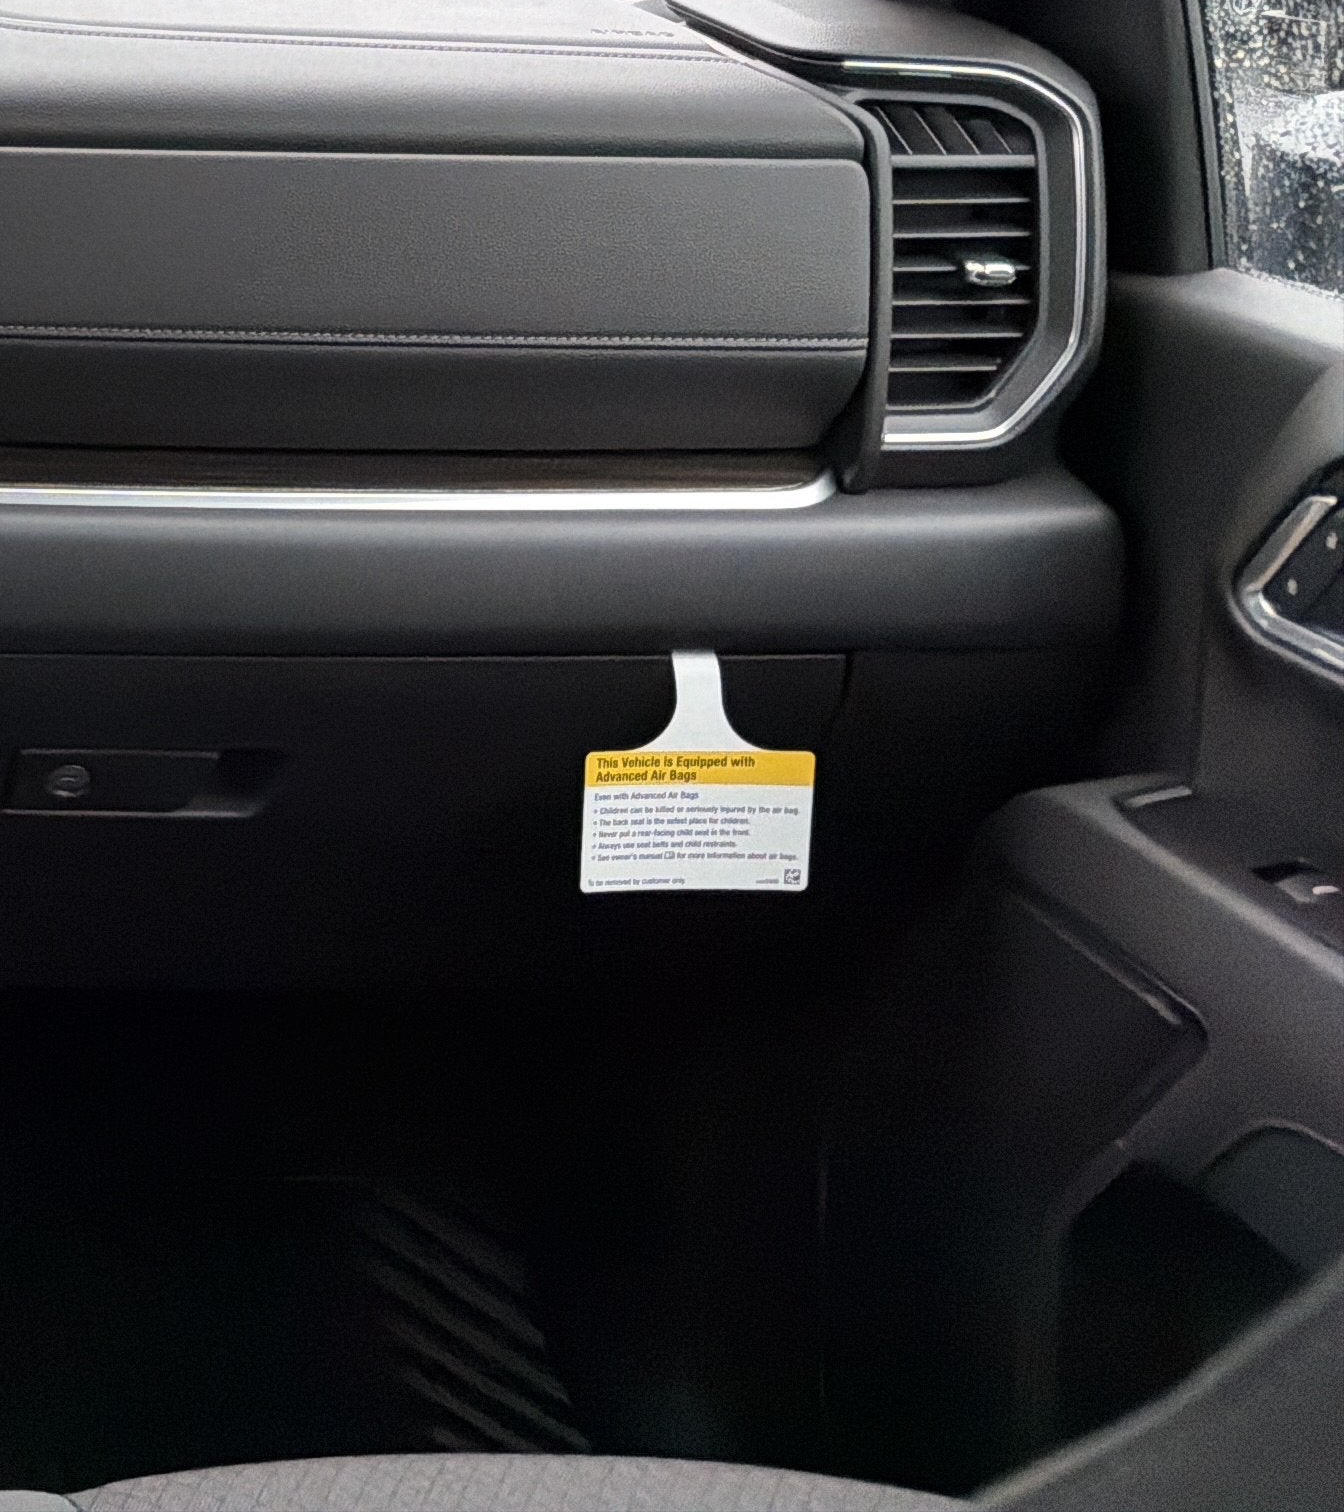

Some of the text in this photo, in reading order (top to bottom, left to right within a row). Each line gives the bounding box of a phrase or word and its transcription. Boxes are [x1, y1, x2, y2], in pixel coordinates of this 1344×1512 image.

[596, 756, 755, 769] This Vehicle is Equipped with
[596, 769, 697, 783] Advanced Air Bags
[594, 791, 699, 801] Even with Advanced Air Bags
